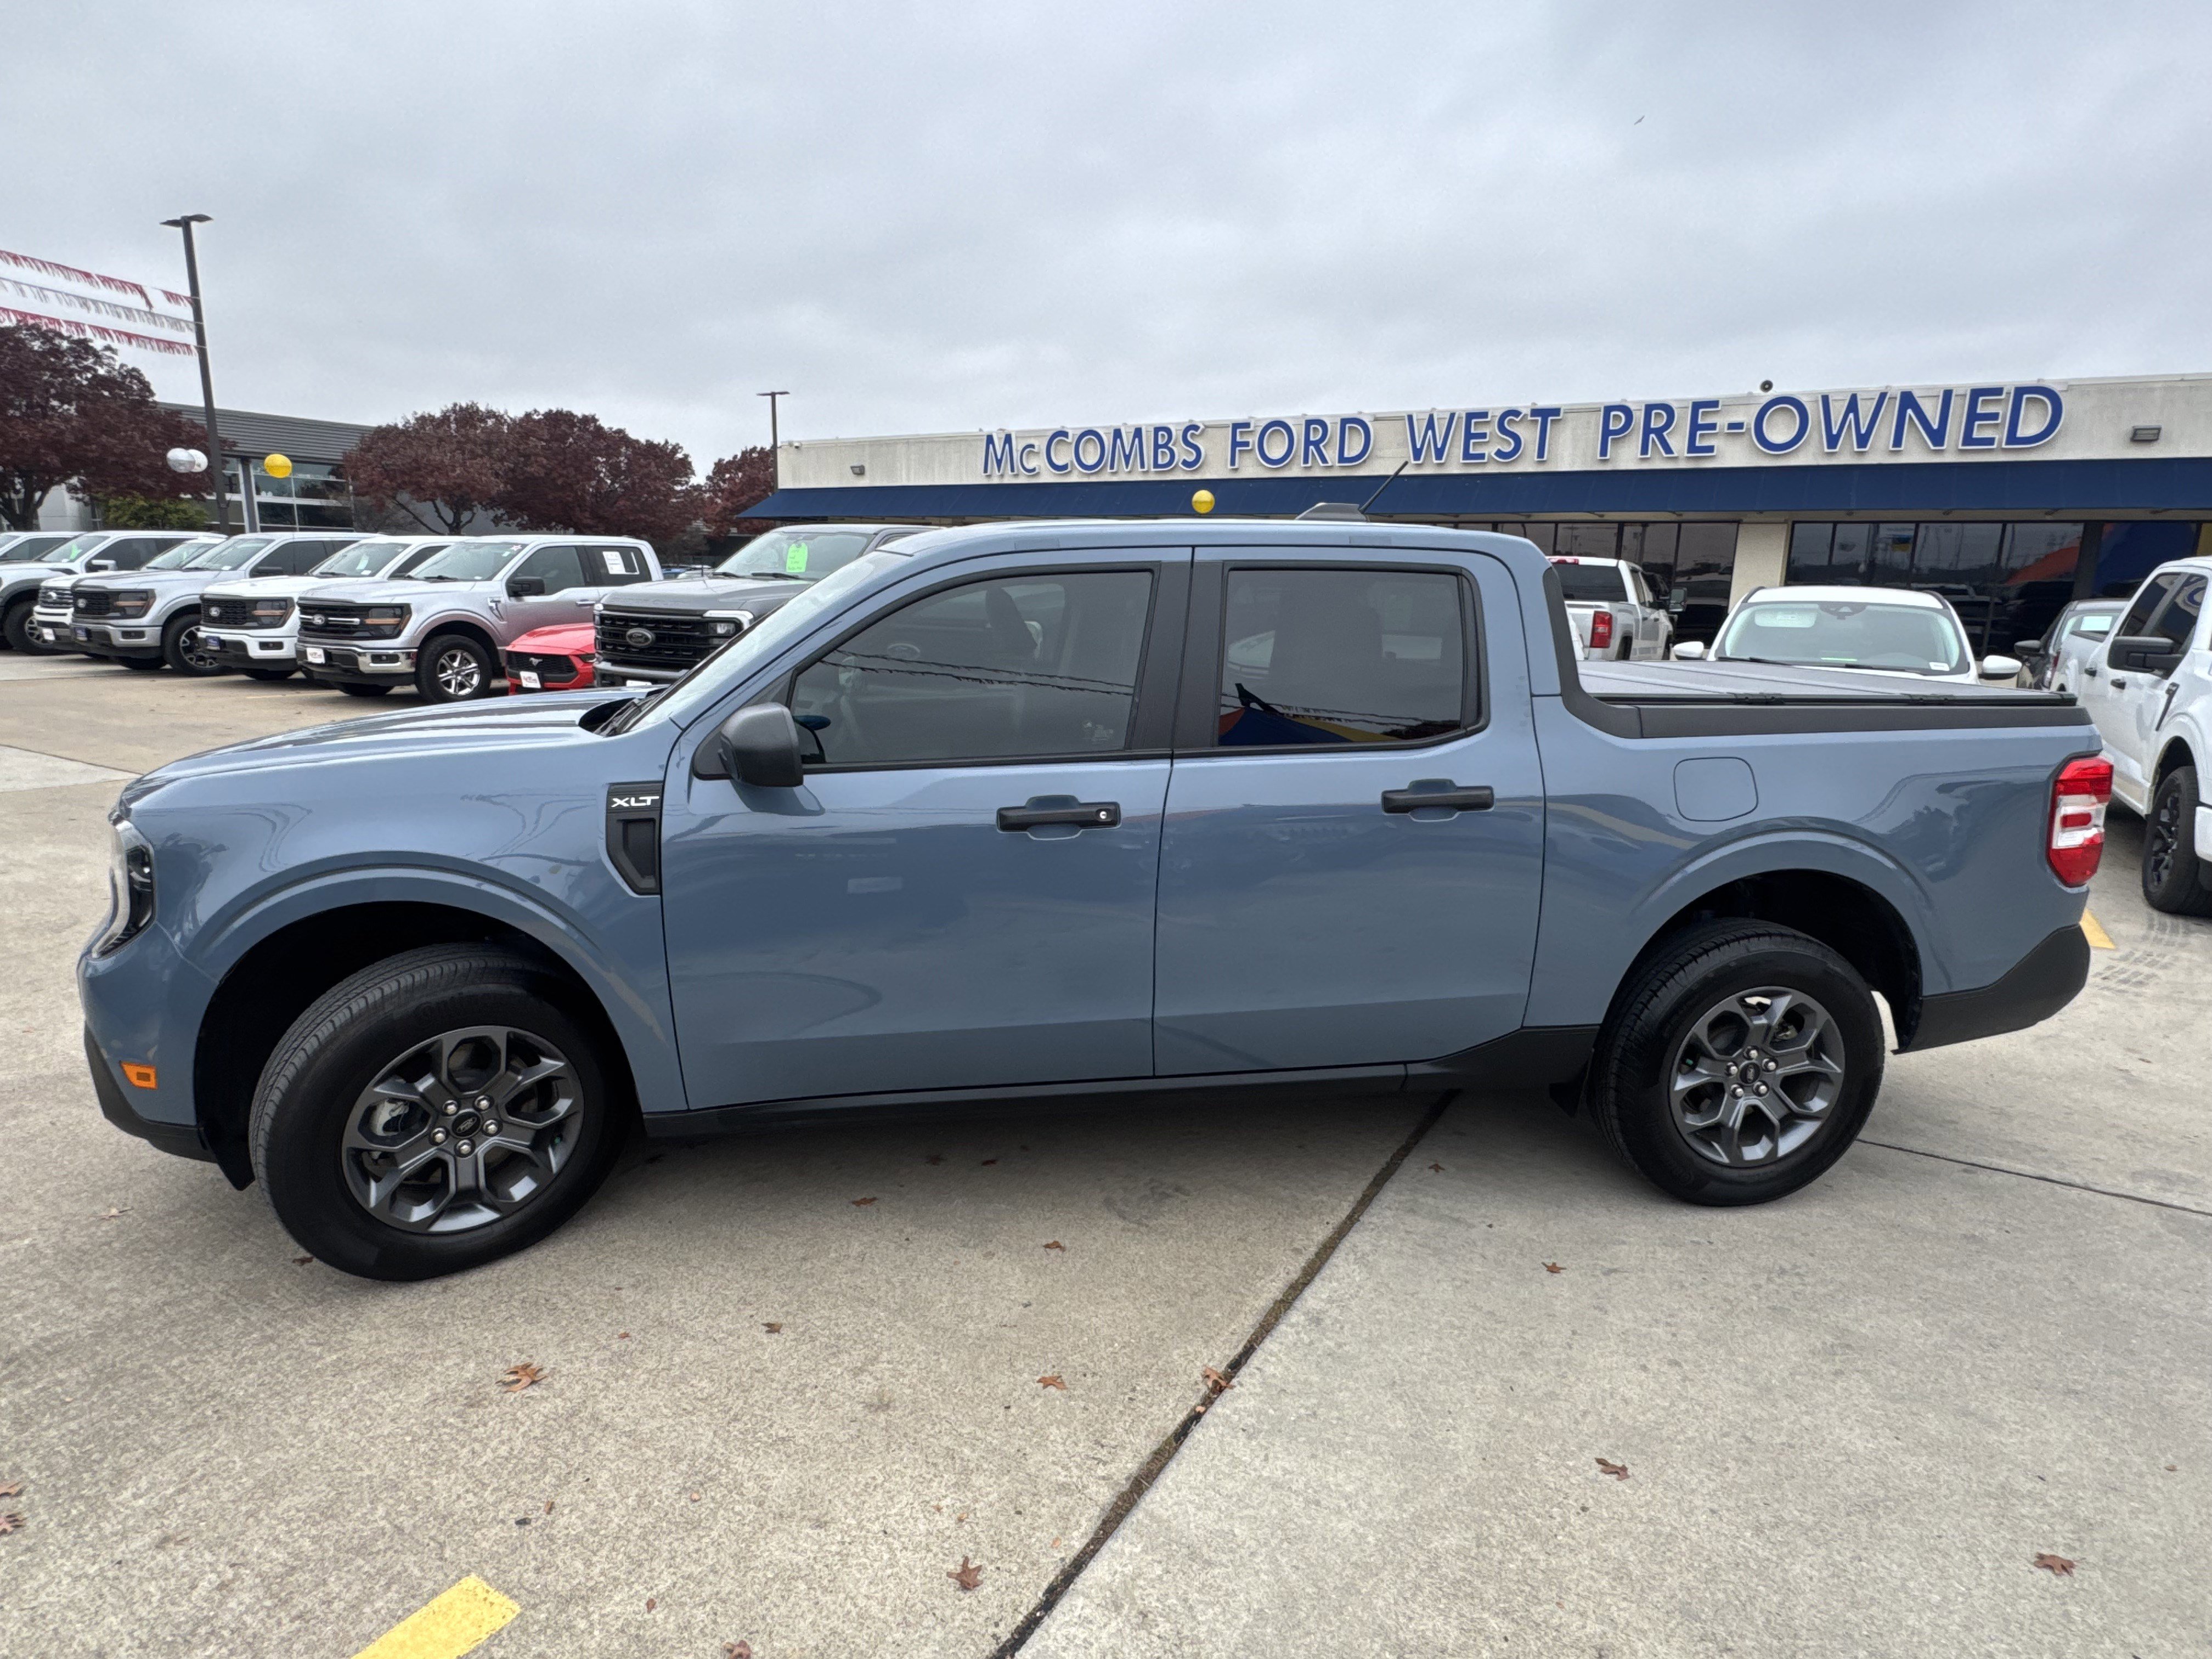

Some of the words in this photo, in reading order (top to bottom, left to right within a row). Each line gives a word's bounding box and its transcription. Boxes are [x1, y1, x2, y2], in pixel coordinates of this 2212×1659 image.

[983, 423, 1204, 473] McCOMBS
[1228, 415, 1373, 467] FORD
[1406, 407, 1561, 462] WEST
[1598, 384, 2064, 459] PRE-OWNED
[611, 795, 659, 808] XLT
